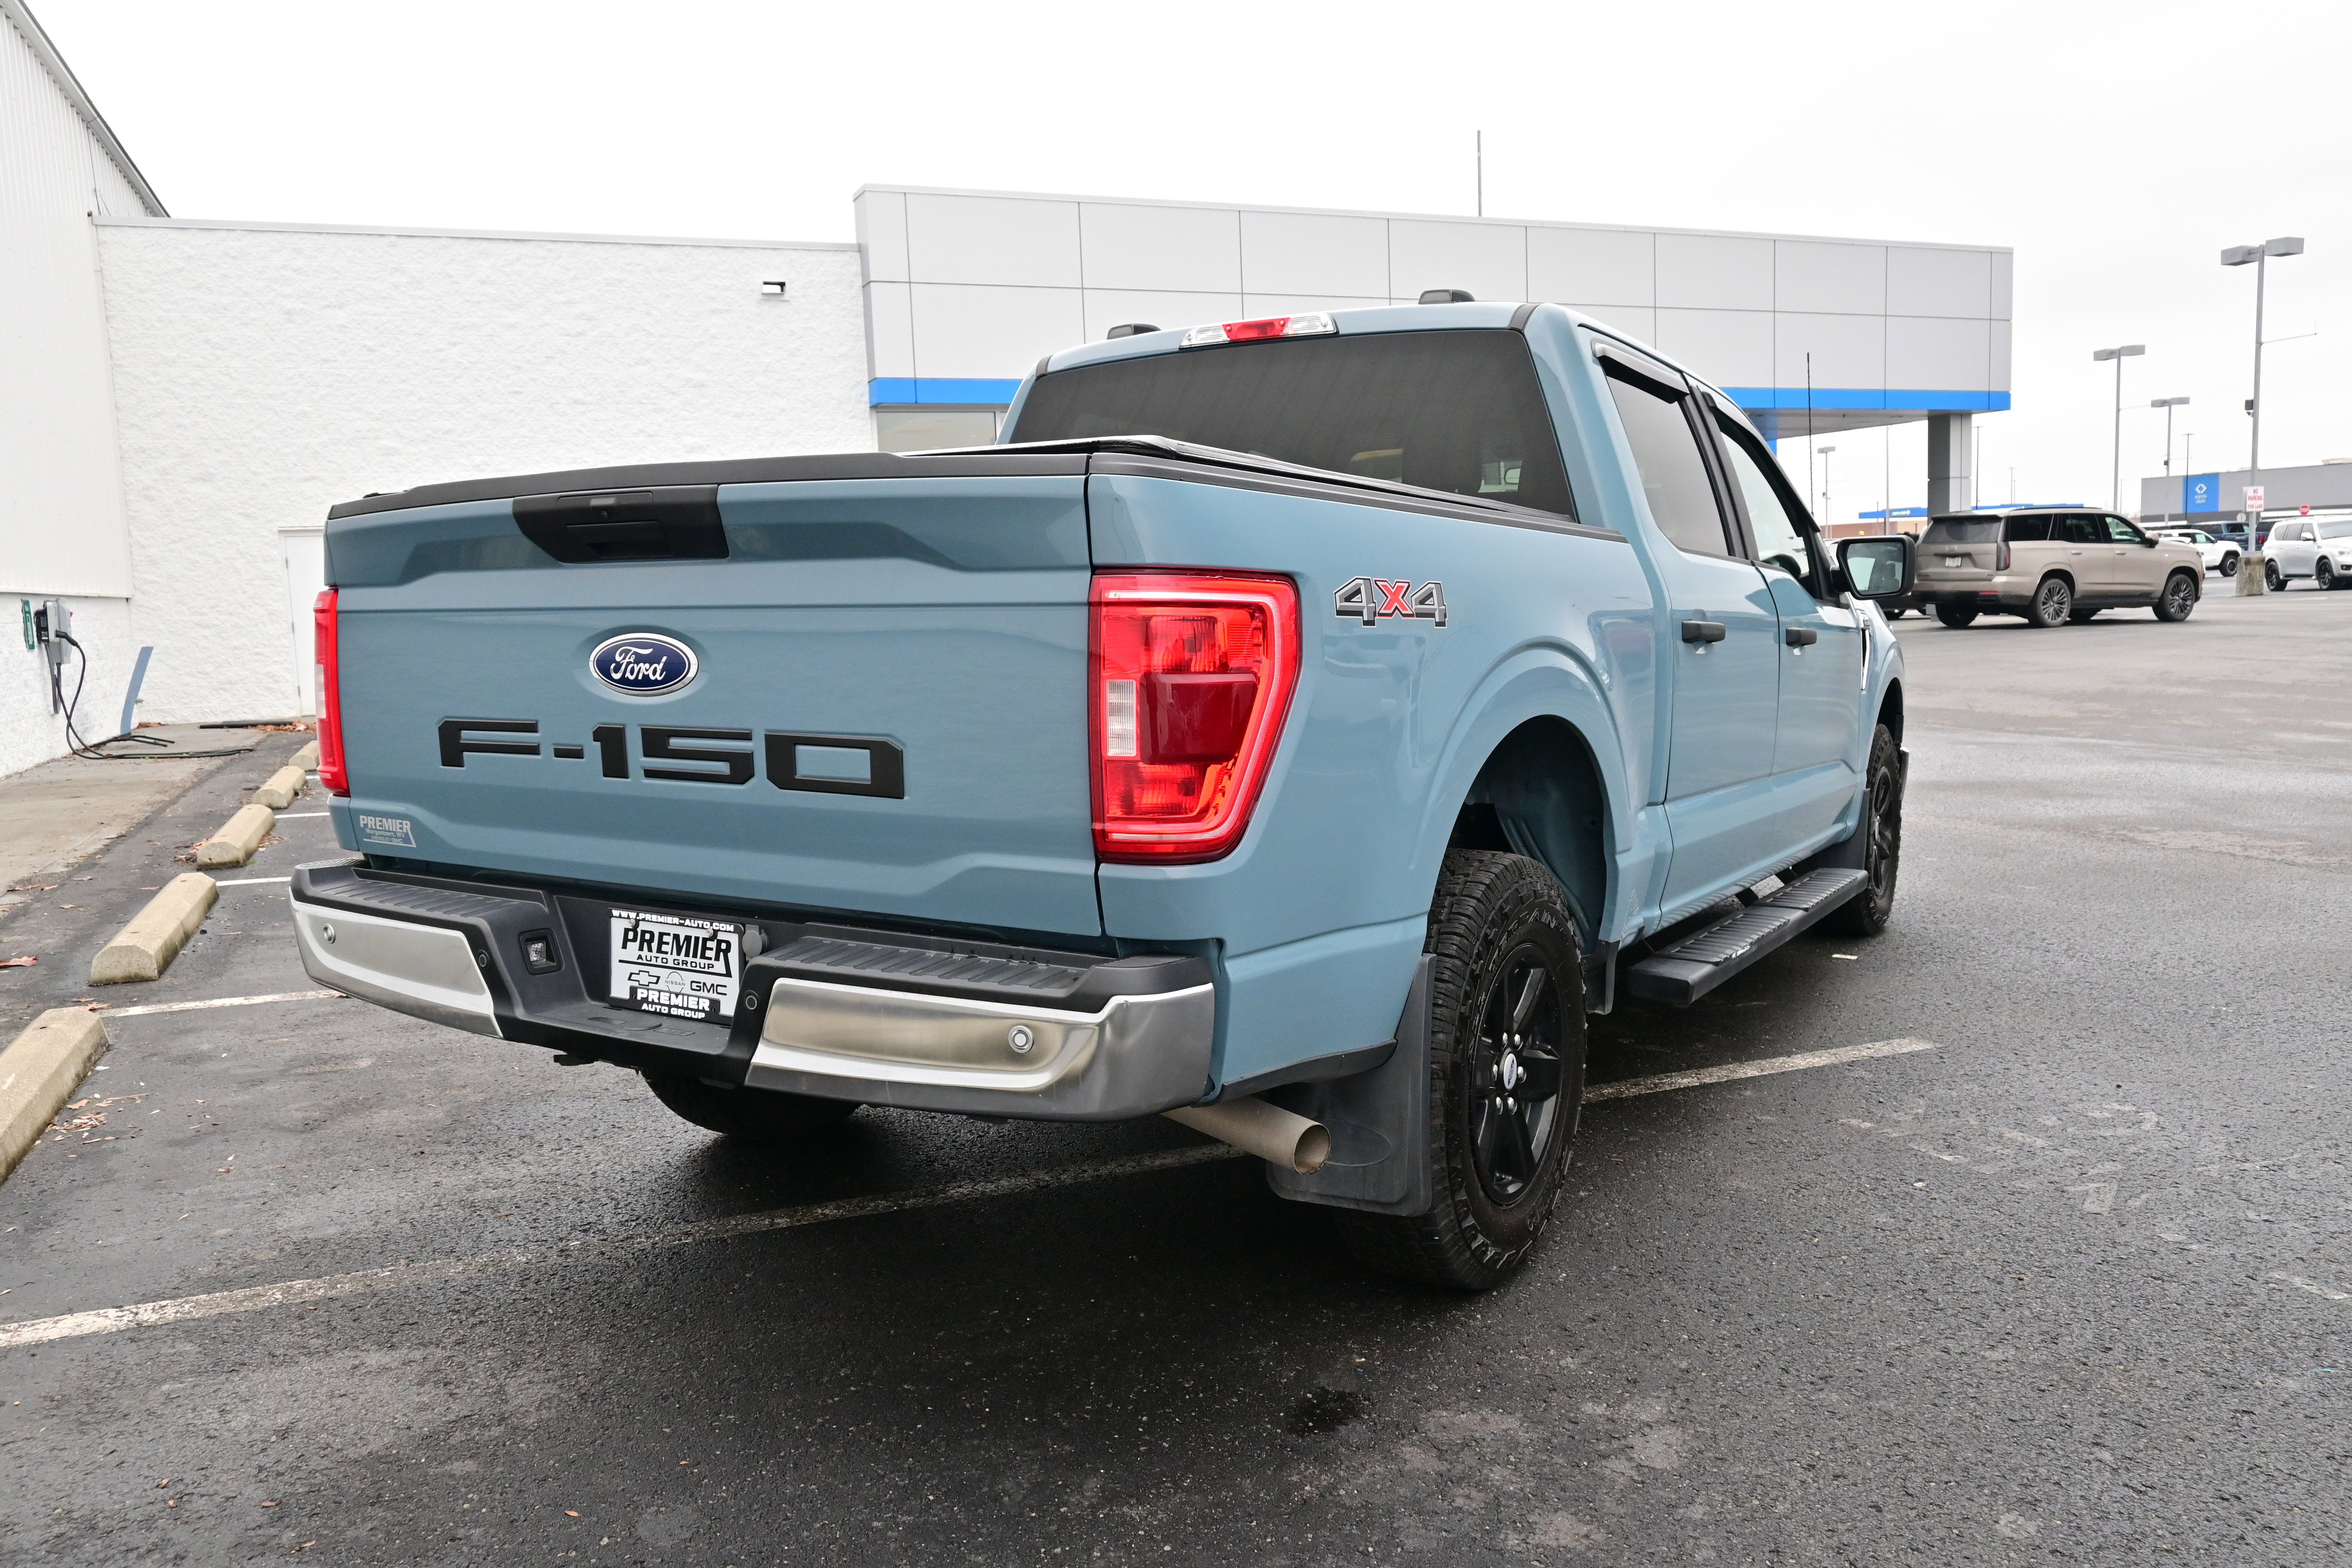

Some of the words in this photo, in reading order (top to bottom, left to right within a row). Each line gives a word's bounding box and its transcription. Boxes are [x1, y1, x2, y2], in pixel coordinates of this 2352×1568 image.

[609, 646, 666, 681] Ford
[438, 719, 905, 799] F-150
[359, 815, 411, 833] PREMIER
[612, 909, 734, 932] WWW.PREMIER-AUTO.COM
[621, 927, 731, 961] PREMIER
[637, 954, 668, 964] AUTO
[673, 959, 714, 970] GROUP
[637, 988, 710, 1011] PREMIER
[690, 980, 727, 996] GMC
[641, 1003, 668, 1014] AUTO
[670, 1007, 705, 1019] GROUP
